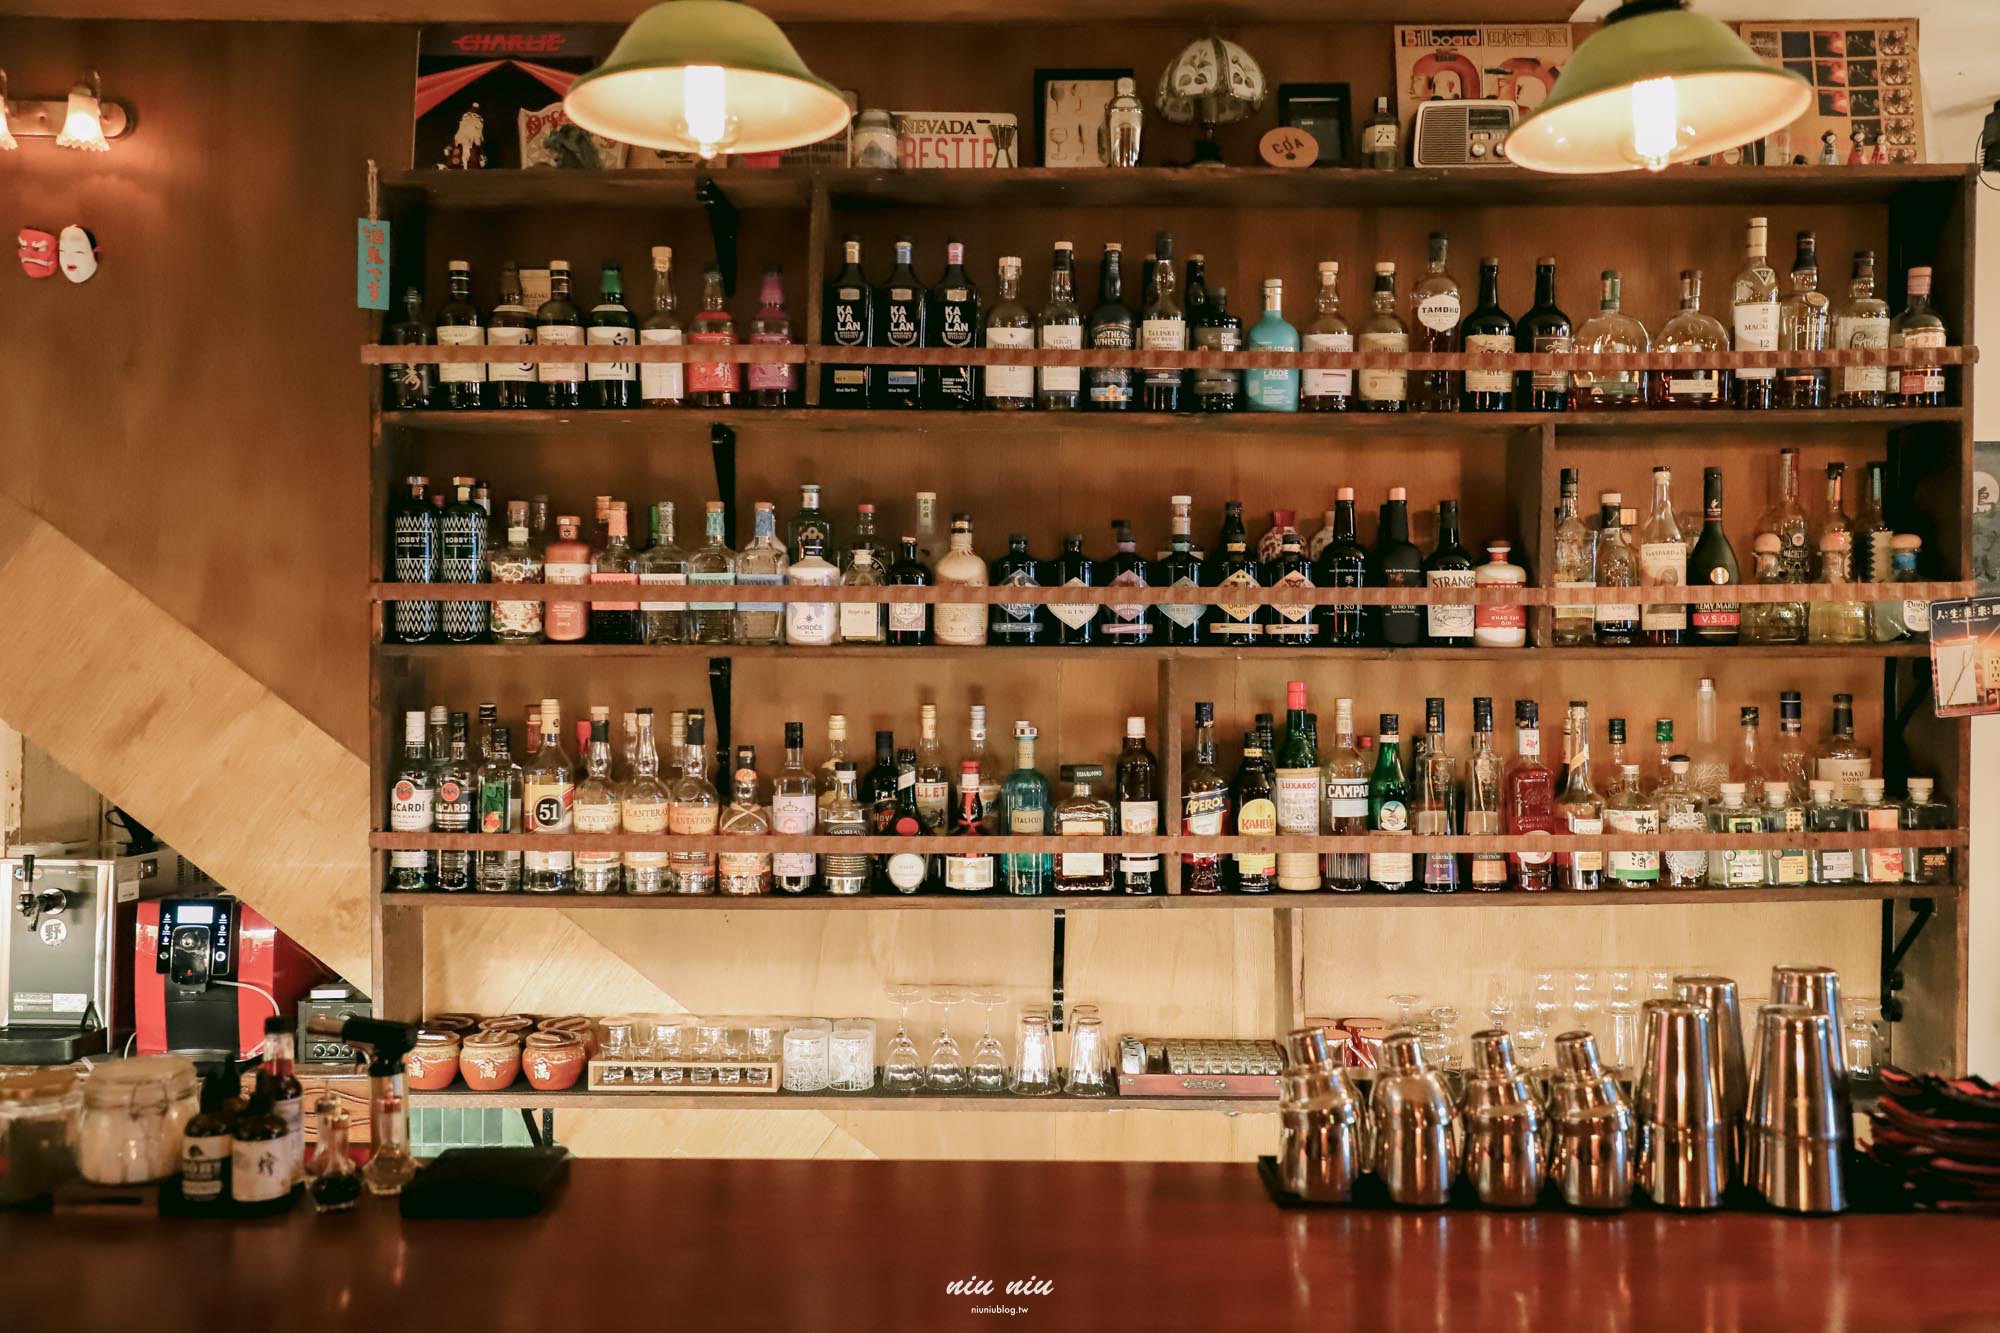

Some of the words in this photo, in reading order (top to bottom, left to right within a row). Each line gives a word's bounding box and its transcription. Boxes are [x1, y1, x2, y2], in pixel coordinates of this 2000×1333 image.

[453, 33, 566, 52] CHARLIE
[1402, 30, 1482, 47] Billboard
[901, 119, 977, 135] NEVADA
[836, 305, 853, 315] KA
[890, 305, 907, 315] KA
[945, 306, 961, 315] KA
[837, 314, 853, 323] VA
[891, 314, 907, 323] VA
[945, 314, 961, 323] VA
[837, 322, 861, 331] LAN
[890, 322, 914, 331] LAN
[945, 322, 969, 332] LAN
[1106, 330, 1121, 338] THE
[1094, 338, 1132, 347] WHISTLER
[1759, 339, 1770, 348] 12
[916, 786, 946, 798] LLET
[1327, 784, 1369, 798] CAMPA
[391, 800, 426, 812] ACARDÍ
[435, 800, 471, 813] ACARDÍ
[1185, 795, 1225, 815] APEROL
[539, 803, 560, 820] 51
[1014, 817, 1043, 825] ITALICUS
